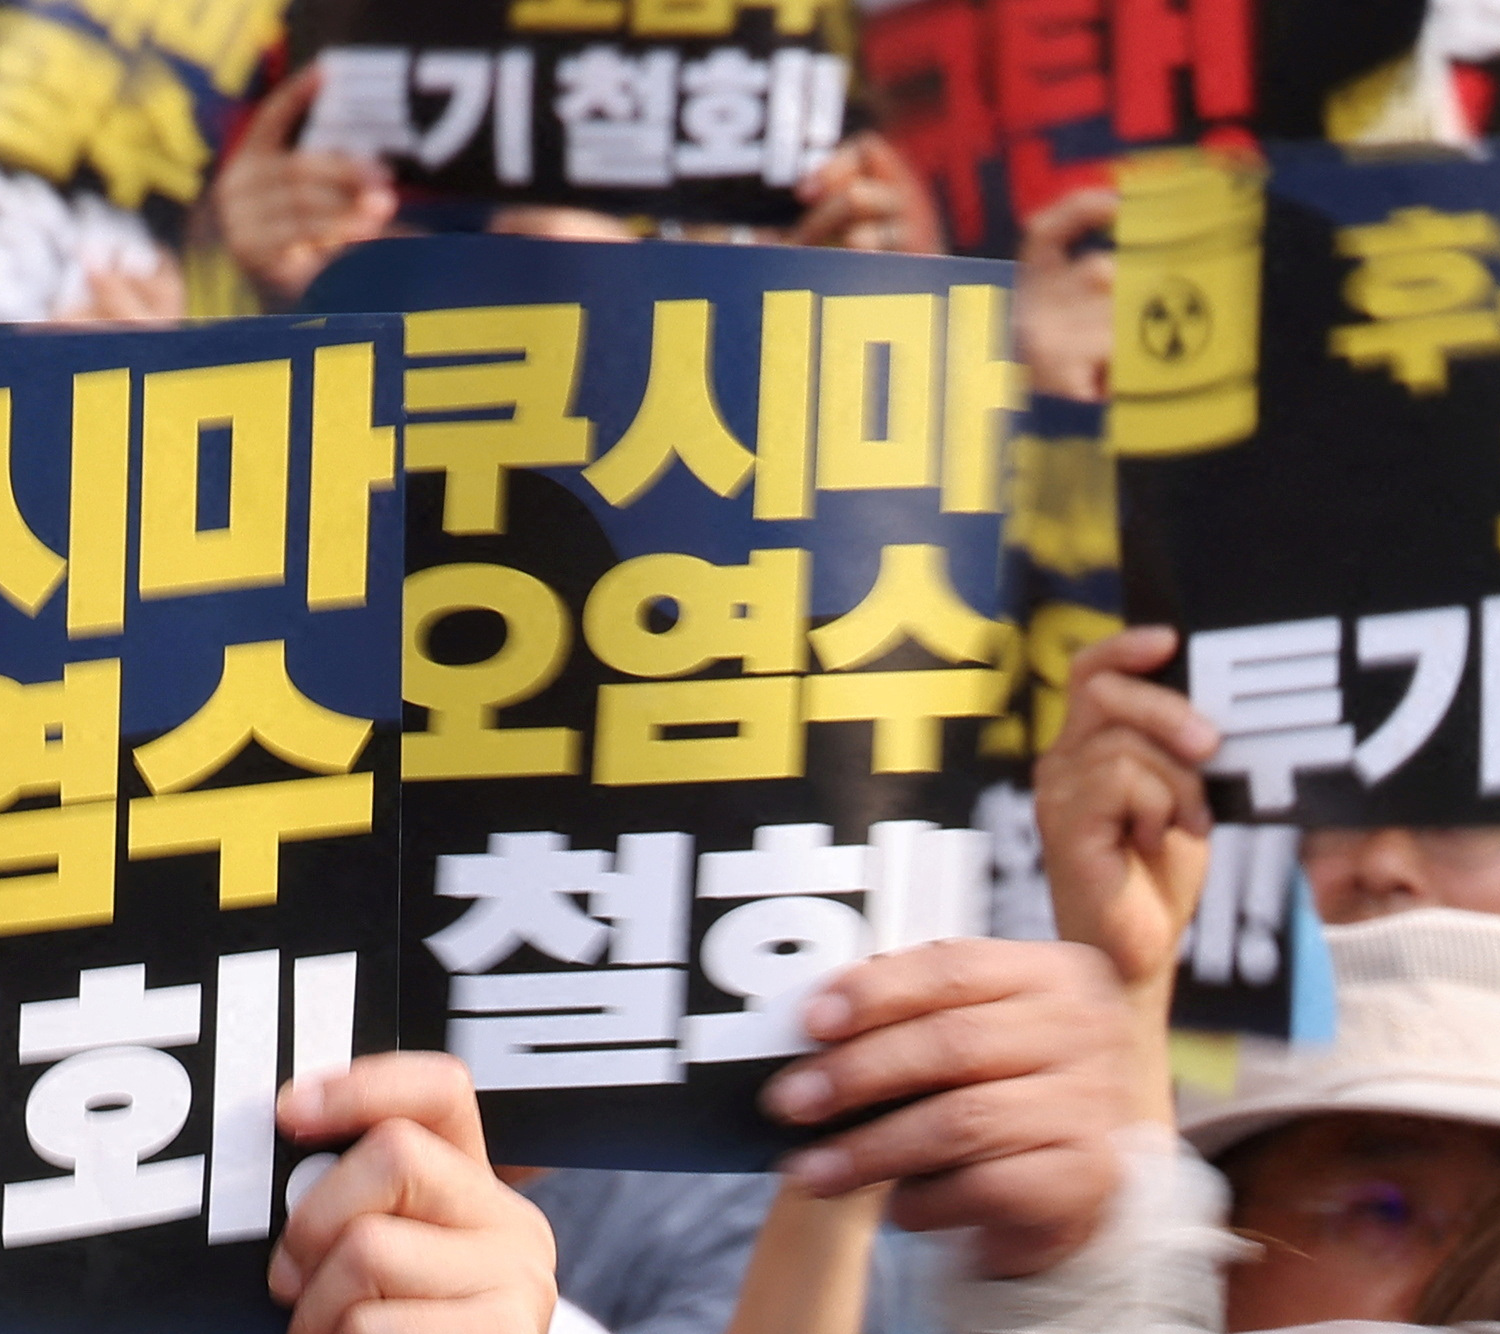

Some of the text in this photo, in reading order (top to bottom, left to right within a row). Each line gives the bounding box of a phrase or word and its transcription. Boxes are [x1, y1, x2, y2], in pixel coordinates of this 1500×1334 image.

[300, 45, 535, 188] 투기
[403, 283, 1032, 535] 쿠시마
[400, 542, 1015, 786] 오염수
